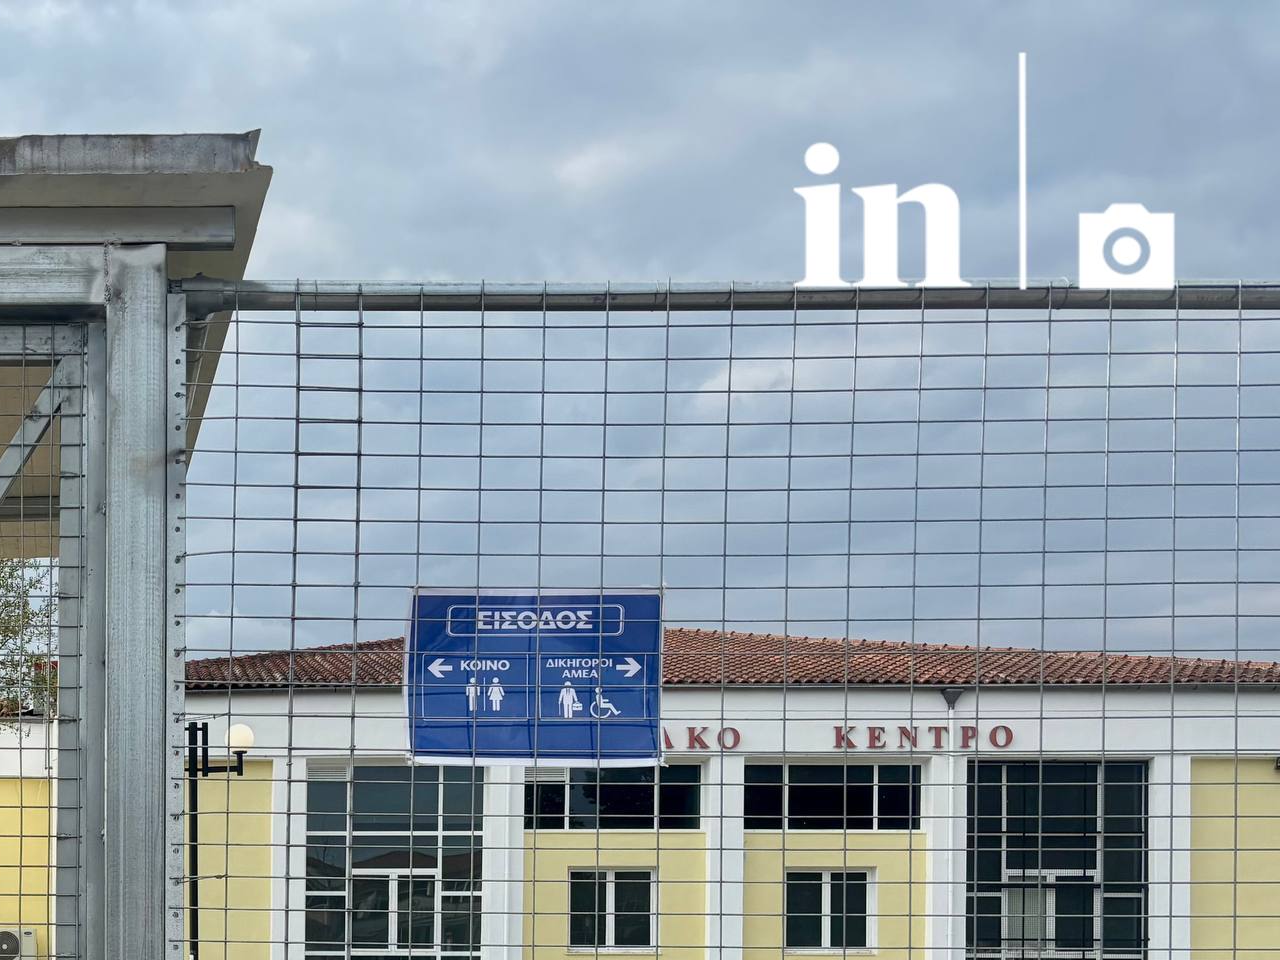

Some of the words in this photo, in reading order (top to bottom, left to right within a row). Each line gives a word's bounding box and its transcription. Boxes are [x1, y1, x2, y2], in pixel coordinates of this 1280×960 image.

[477, 610, 593, 630] ΕΙΣΟΔΟΣ
[460, 659, 510, 671] ΚΟΙΝΟ
[546, 657, 613, 669] ΔΙΚΗΓΟΡΟΙ
[562, 669, 599, 679] ΑΜΕΑ
[833, 725, 1013, 749] ΚΕΝΤΡΟ
